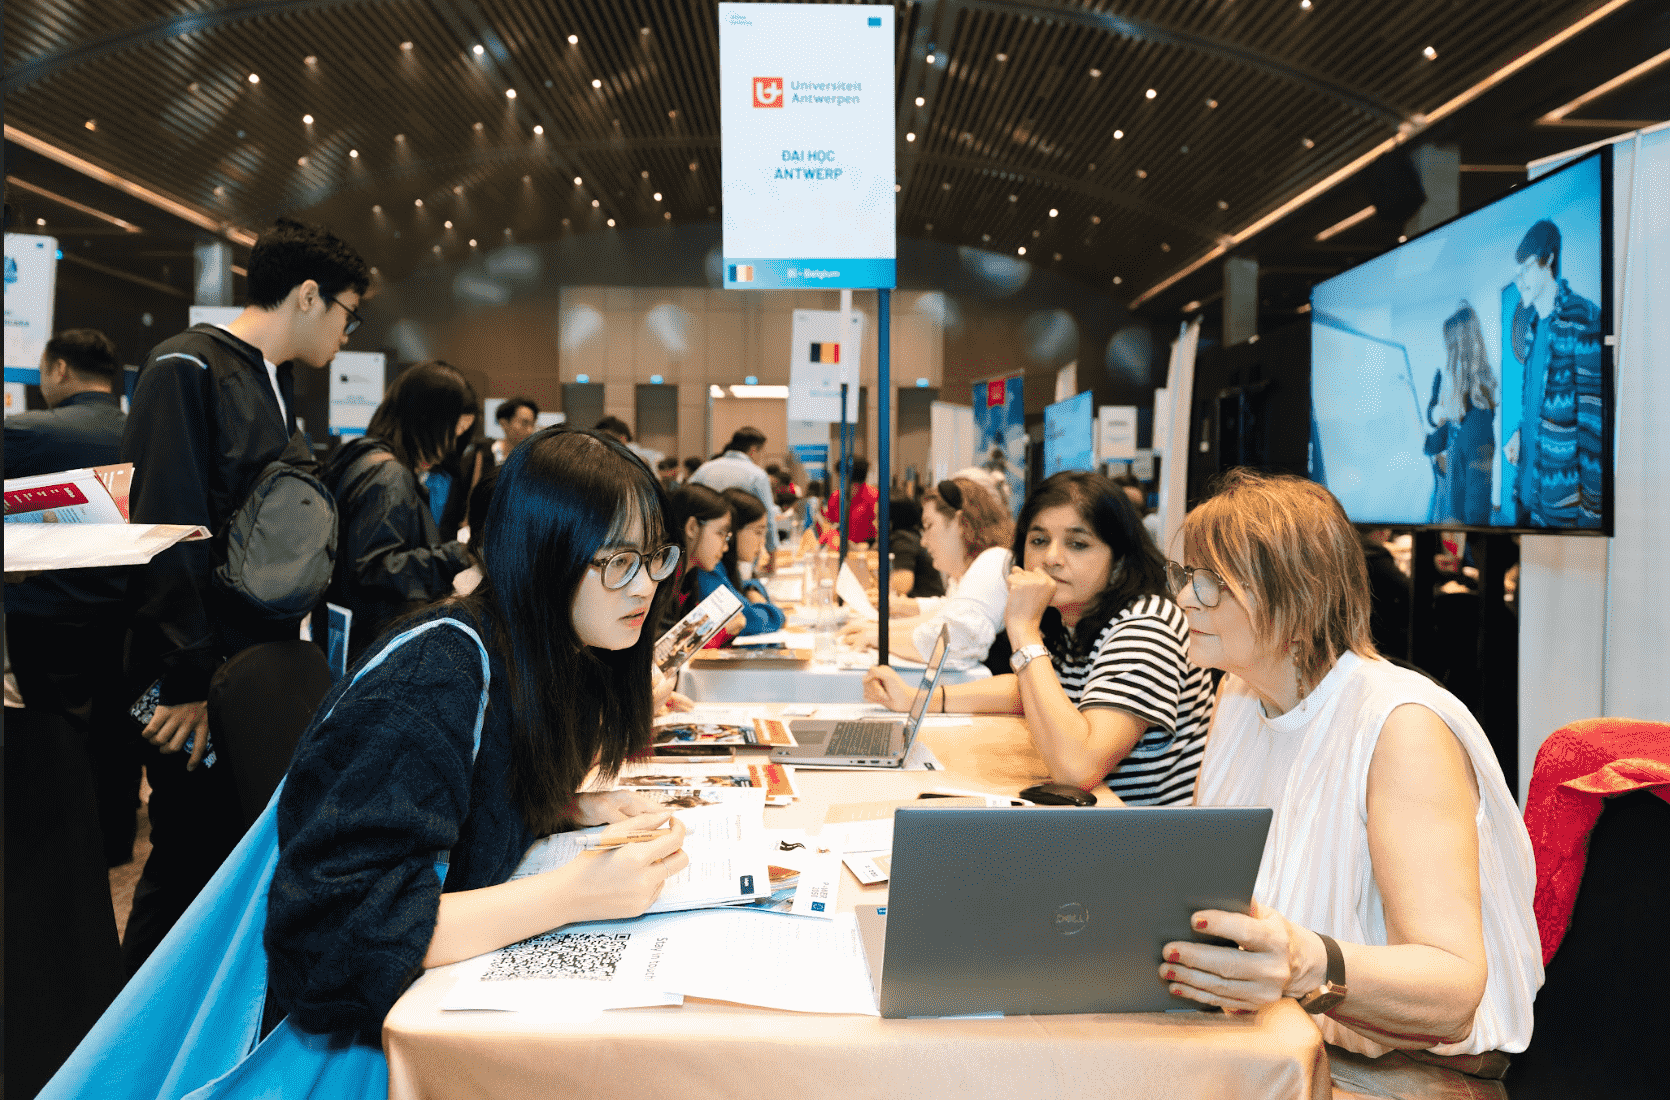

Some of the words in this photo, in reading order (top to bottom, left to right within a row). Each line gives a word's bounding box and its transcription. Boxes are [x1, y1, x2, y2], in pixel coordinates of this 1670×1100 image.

[791, 81, 862, 91] Universiteit
[792, 93, 860, 106] Antwerpen
[807, 150, 835, 164] HỌC
[774, 168, 843, 180] ANTWERP
[1056, 914, 1085, 923] DELL
[650, 938, 668, 951] Stay
